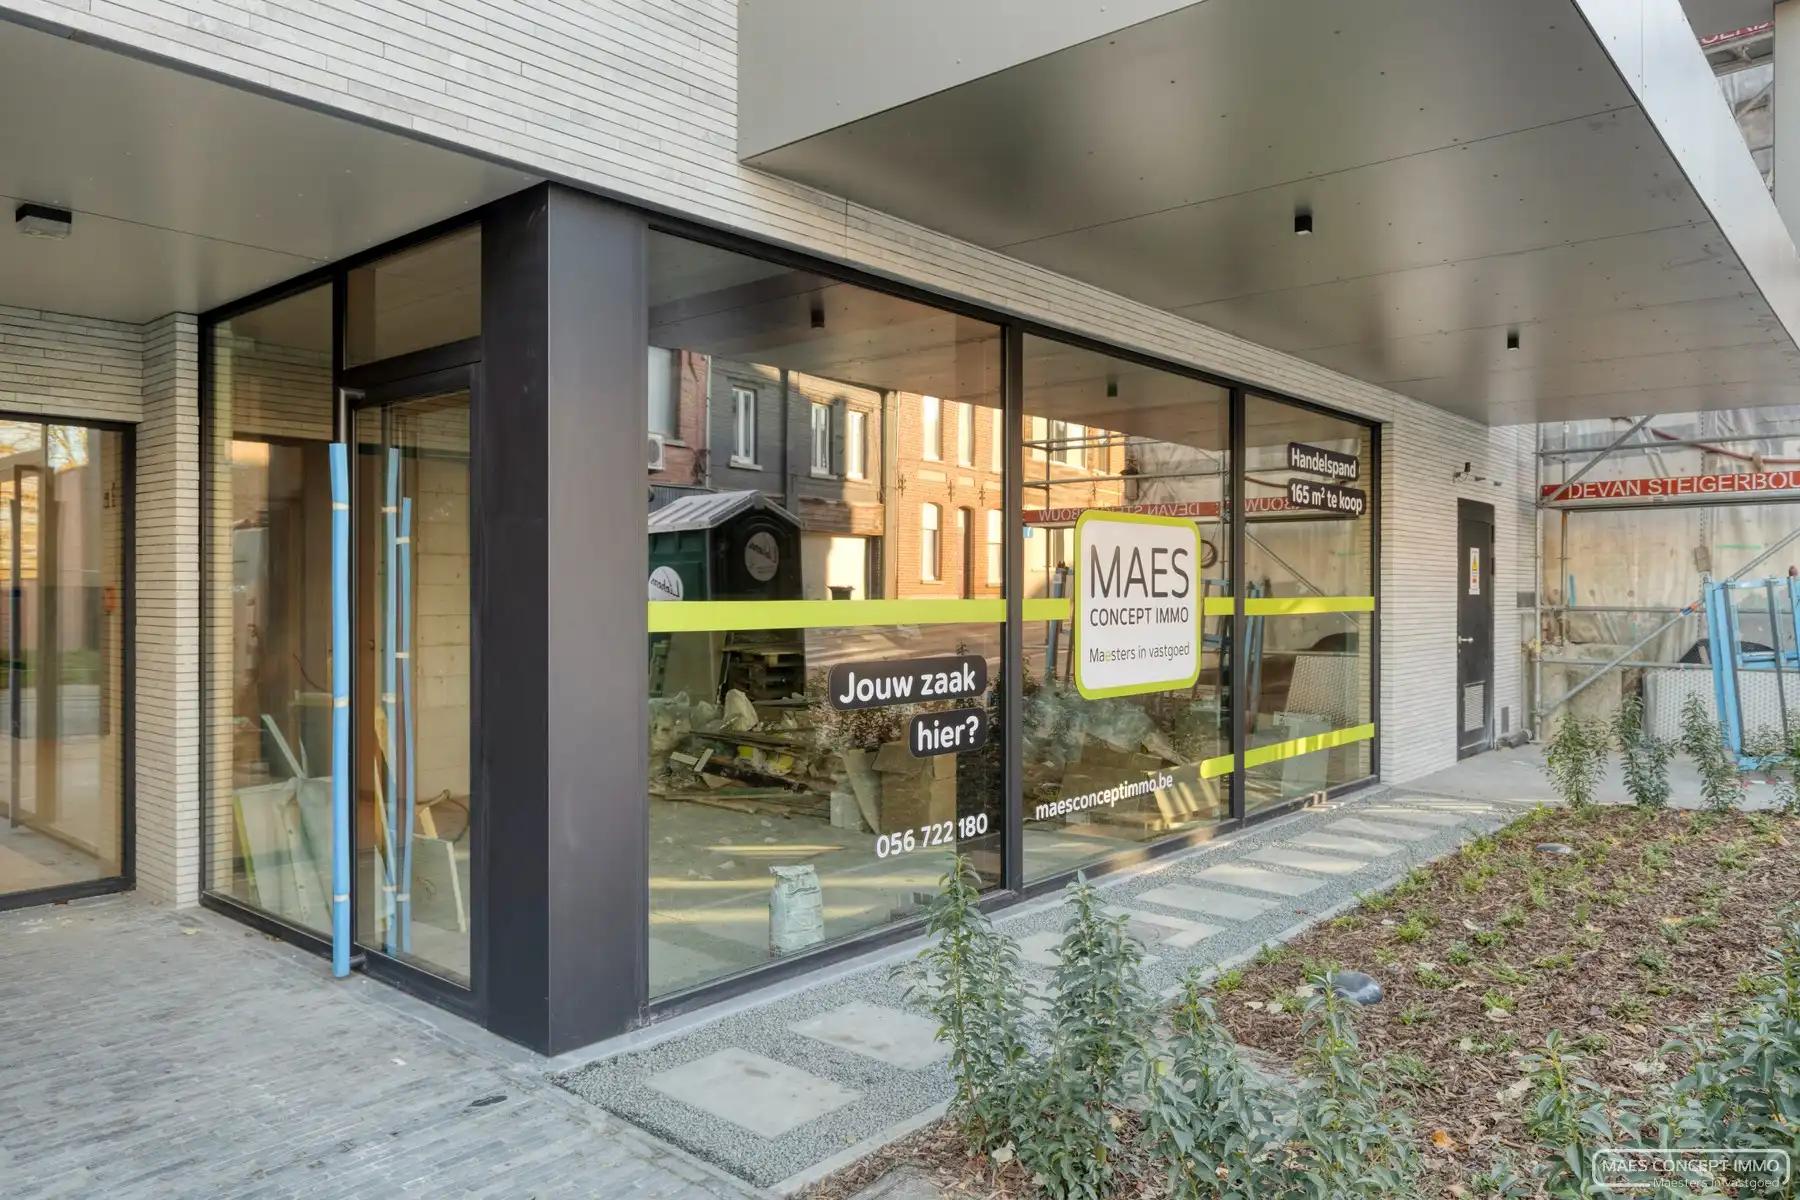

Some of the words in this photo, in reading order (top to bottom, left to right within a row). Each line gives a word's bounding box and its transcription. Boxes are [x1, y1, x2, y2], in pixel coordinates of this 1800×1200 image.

[1291, 447, 1356, 478] Handelspand
[1291, 483, 1309, 504] 165
[1327, 491, 1337, 508] te
[1339, 491, 1363, 515] koop
[1568, 480, 1641, 499] DEVAN
[1091, 544, 1189, 598] MAES
[1090, 608, 1152, 627] CONCEPT
[1155, 606, 1189, 624] IMMO
[1089, 647, 1136, 663] Maesters
[1138, 645, 1147, 659] in
[1149, 642, 1190, 661] vastgoed
[839, 671, 913, 704] Jouw
[920, 662, 976, 696] zaak
[917, 715, 979, 751] hier?
[1035, 772, 1173, 821] maesconceptimmo.be
[876, 829, 915, 859] 056
[921, 820, 954, 848] 722
[957, 812, 988, 840] 180
